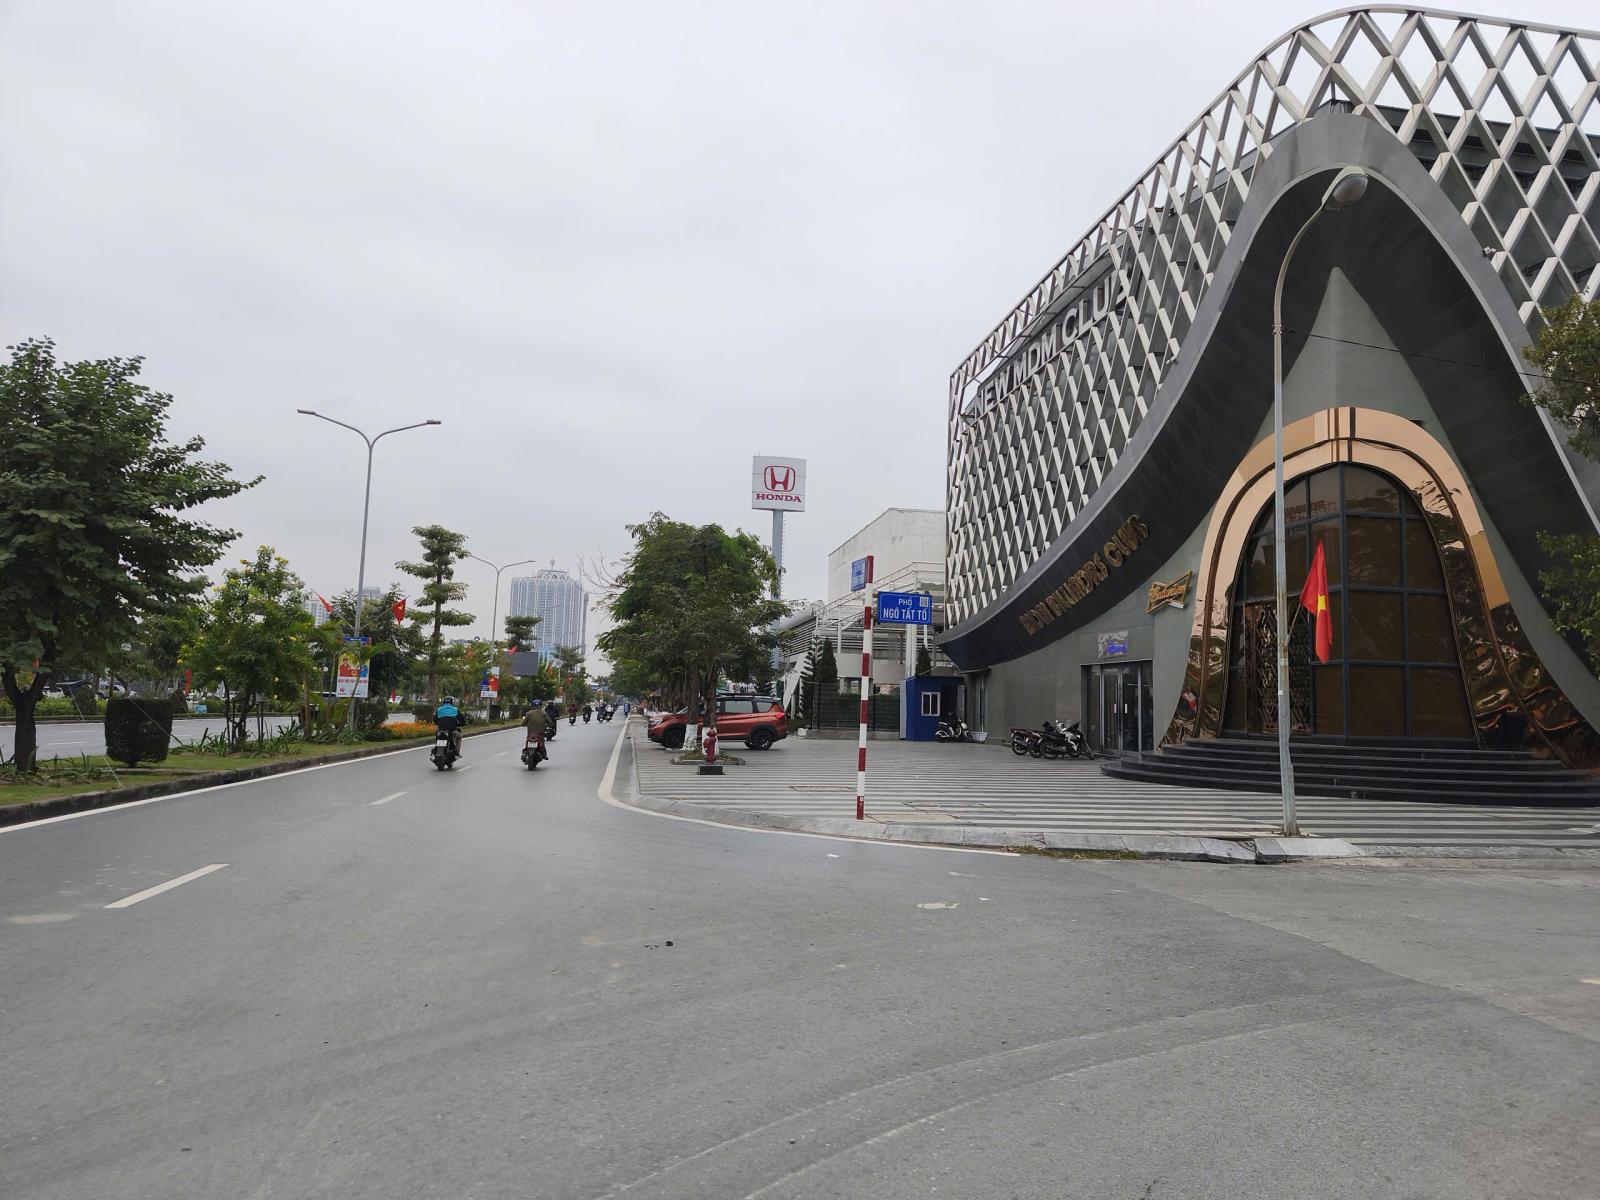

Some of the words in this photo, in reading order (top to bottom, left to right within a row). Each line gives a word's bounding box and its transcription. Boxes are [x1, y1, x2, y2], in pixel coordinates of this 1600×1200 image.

[1013, 322, 1057, 387] MDM
[756, 493, 802, 503] HONDA
[883, 608, 900, 619] NGÔ
[903, 606, 916, 620] TẤT
[918, 607, 928, 621] TỐ
